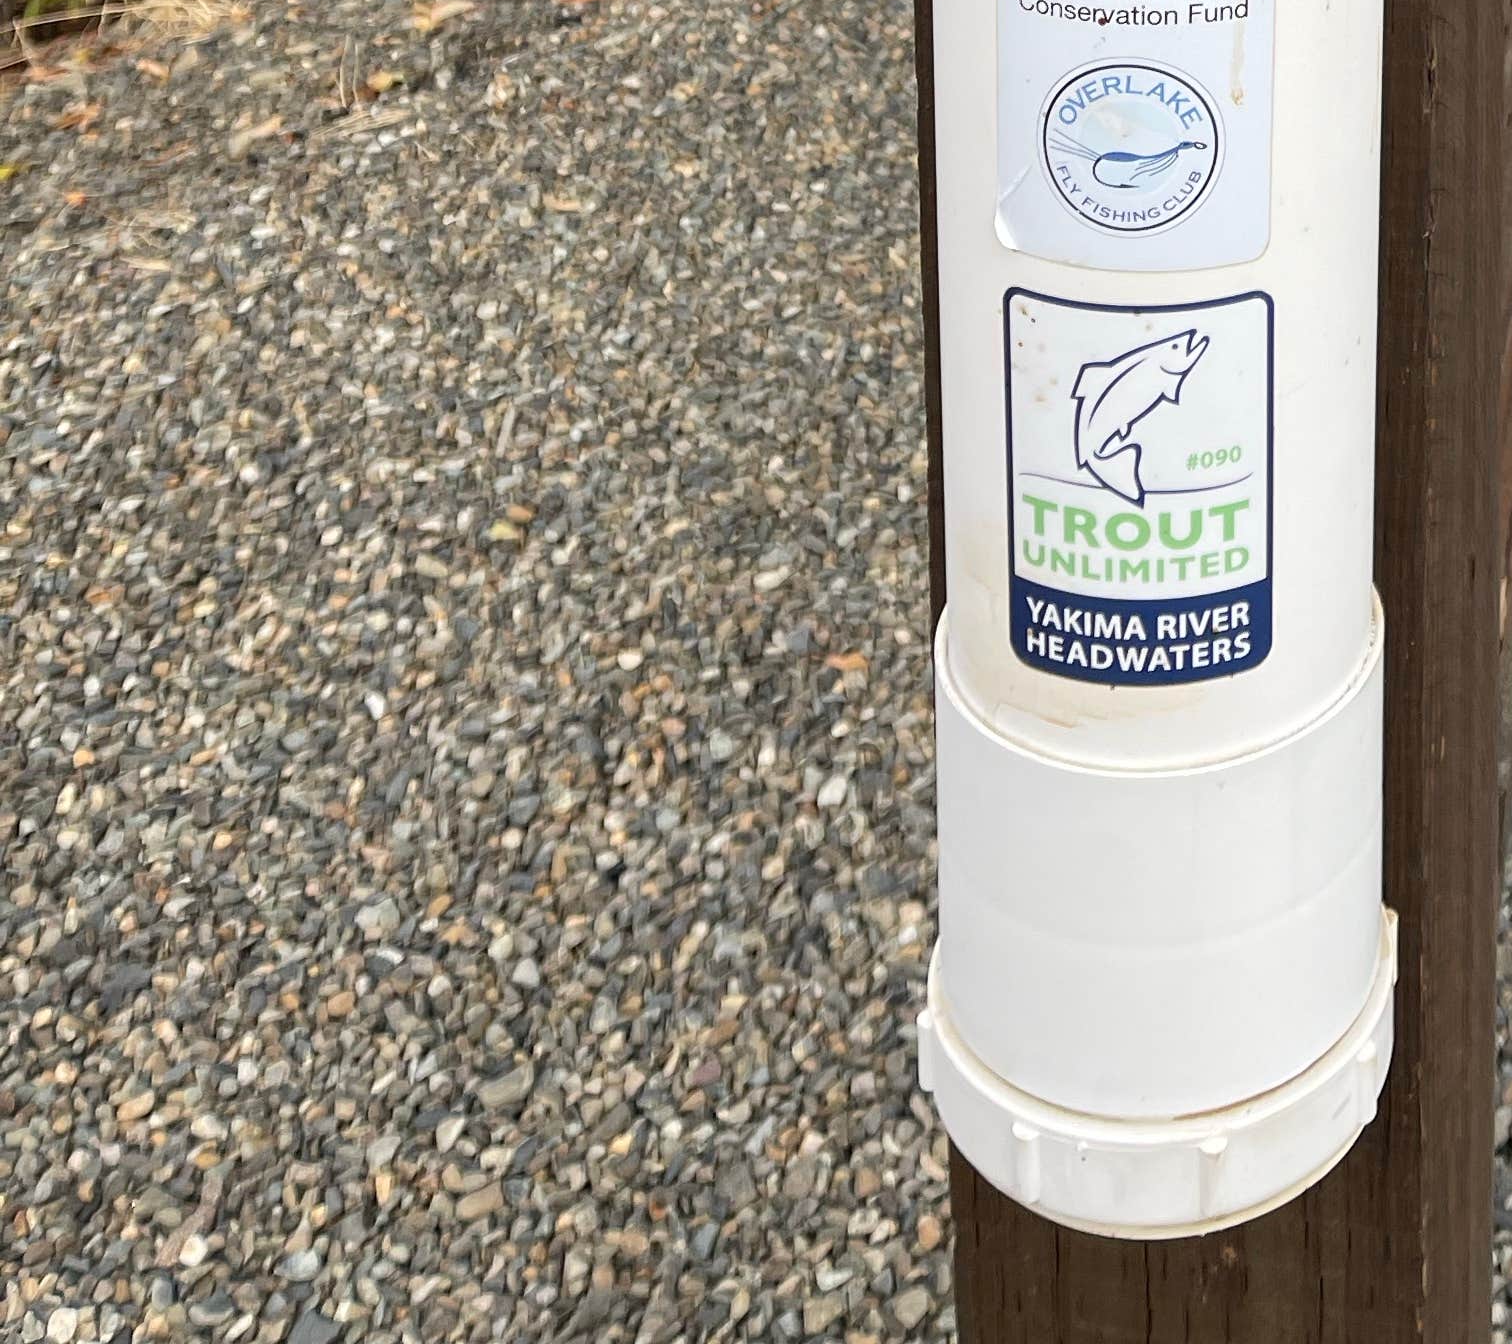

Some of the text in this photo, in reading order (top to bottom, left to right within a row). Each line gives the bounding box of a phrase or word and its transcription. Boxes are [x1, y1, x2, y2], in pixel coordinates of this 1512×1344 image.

[1058, 75, 1203, 130] OVERLAKE
[1056, 164, 1203, 223] FLY FISHING CLUB
[1185, 445, 1242, 471] #090
[1022, 493, 1250, 552] TROUT
[1022, 540, 1250, 583] UNLIMITED
[1026, 596, 1250, 642] YAKIMA RIVER
[1026, 628, 1252, 673] HEADWATERS
